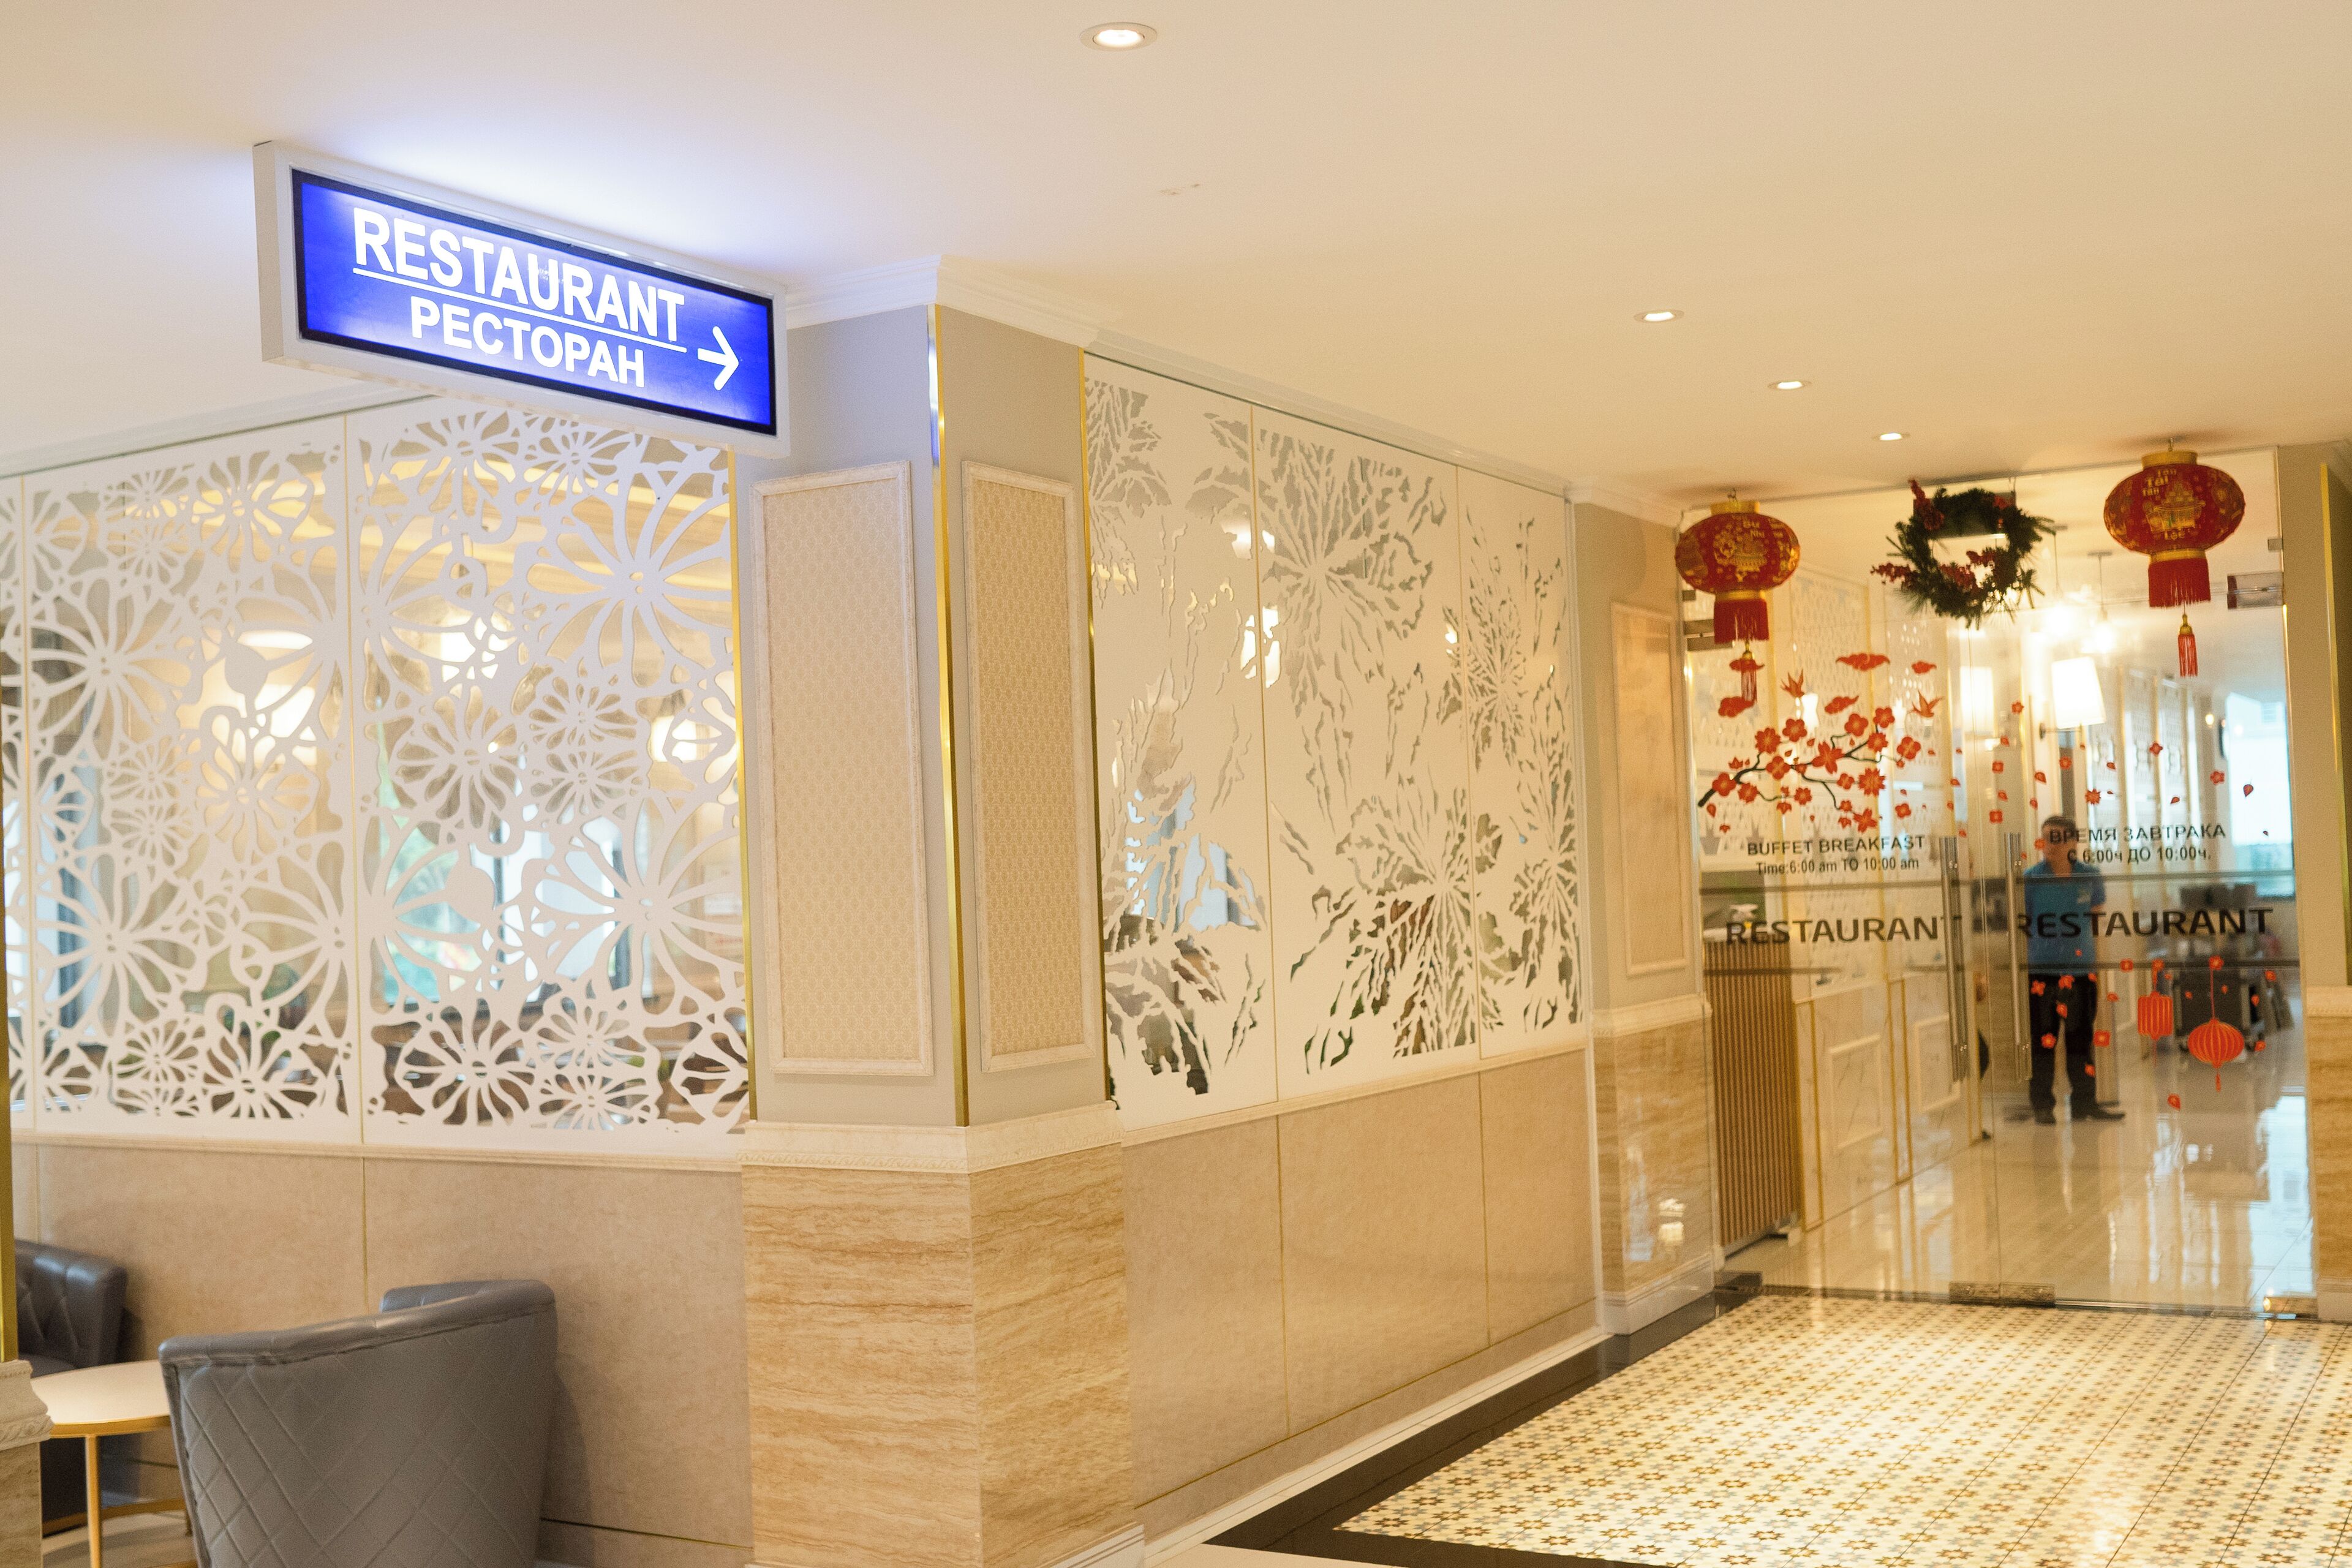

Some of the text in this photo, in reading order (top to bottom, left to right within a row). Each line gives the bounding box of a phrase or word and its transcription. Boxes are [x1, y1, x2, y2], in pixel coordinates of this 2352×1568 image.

[353, 207, 685, 342] RESTAURANT
[410, 296, 644, 388] РЕСТОРАН
[2049, 824, 2226, 844] ВРЕМЯ ЗАВТРАКА
[1747, 835, 1925, 856] BUFFET BREAKFAST
[2127, 846, 2150, 864] ДО
[1819, 861, 1837, 873] am
[1842, 858, 1858, 870] TO
[1864, 858, 1896, 870] 10:00
[1900, 858, 1919, 870] am
[2018, 908, 2274, 938] RESTAURANT
